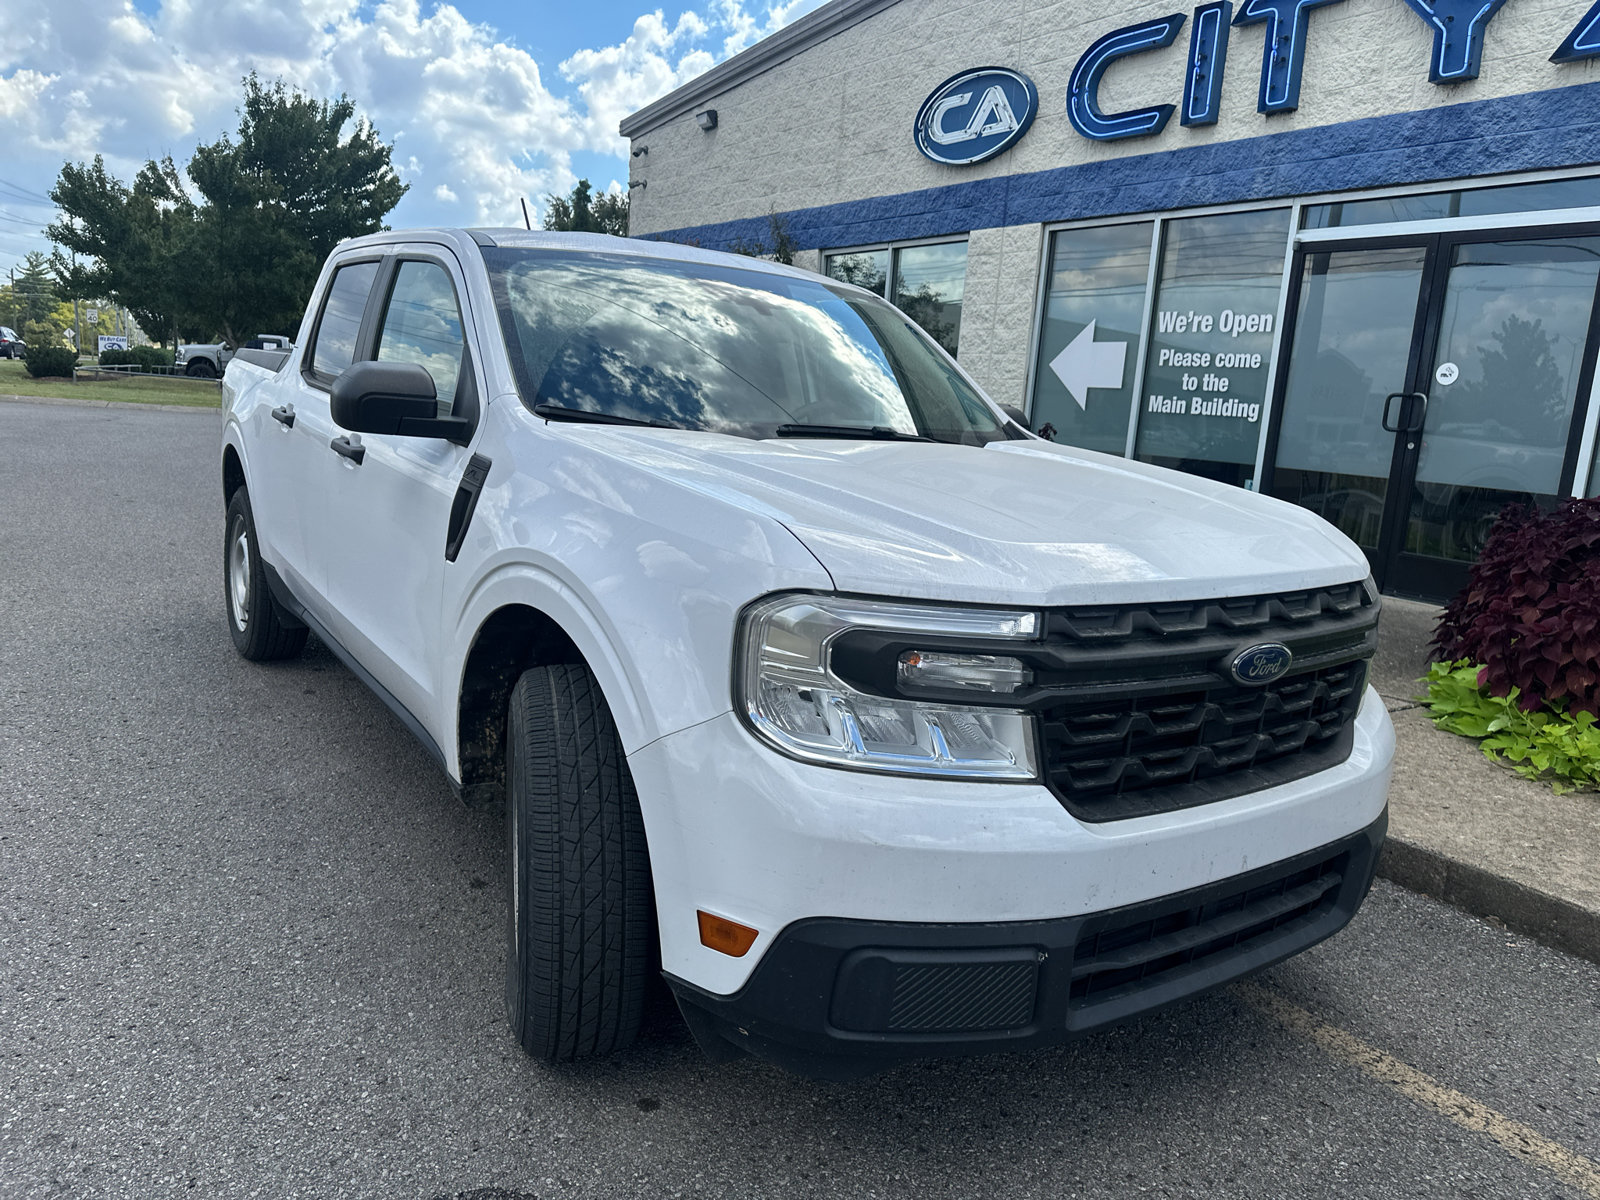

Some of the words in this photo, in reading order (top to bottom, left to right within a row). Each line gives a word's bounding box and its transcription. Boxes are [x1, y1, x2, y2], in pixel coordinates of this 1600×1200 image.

[1066, 0, 1505, 141] CITY
[928, 85, 1019, 145] CA
[1159, 311, 1213, 333] We're
[1219, 309, 1273, 338] Open
[1159, 349, 1211, 367] Please
[1215, 352, 1261, 369] come
[1182, 373, 1198, 391] to
[1202, 373, 1229, 392] the
[1148, 395, 1186, 414] Main
[1190, 396, 1260, 422] Building
[1249, 653, 1282, 677] Ford
